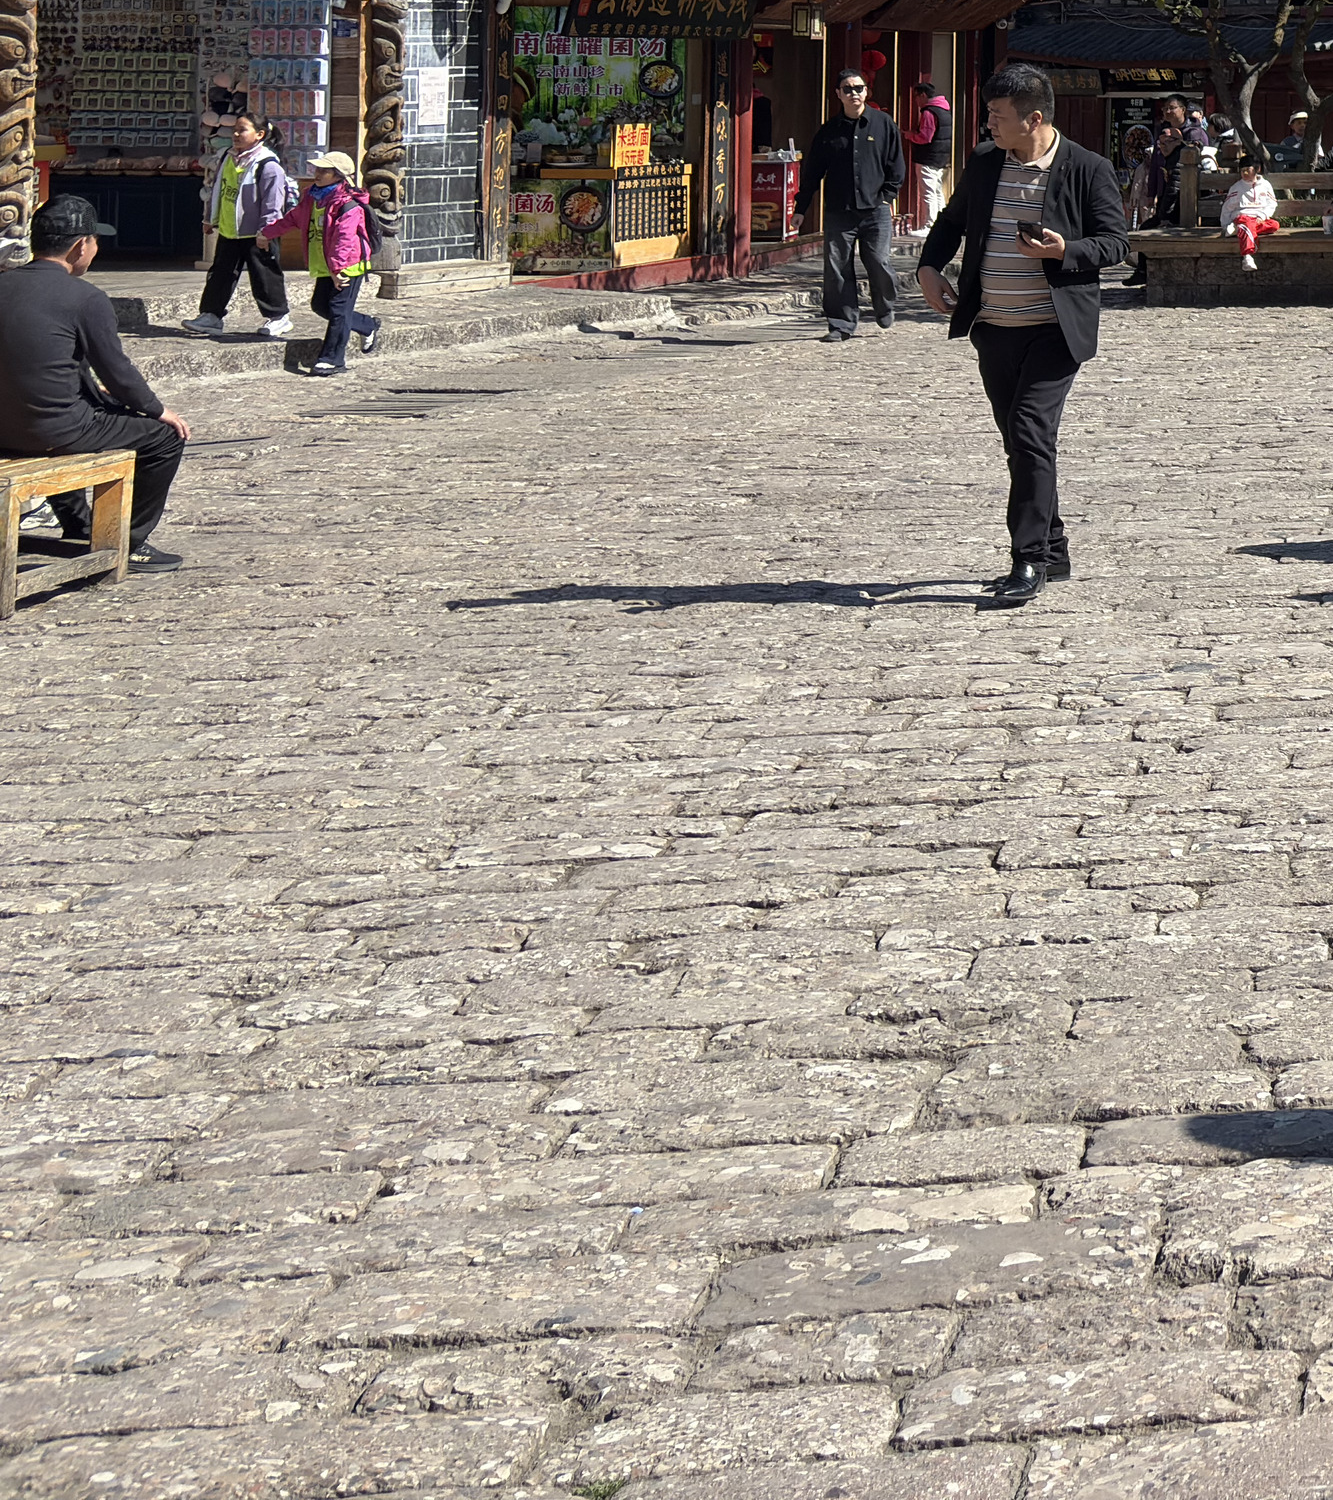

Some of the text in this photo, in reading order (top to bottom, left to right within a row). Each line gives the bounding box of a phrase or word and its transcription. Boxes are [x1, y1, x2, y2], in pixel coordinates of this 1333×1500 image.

[536, 64, 606, 79] 云南山珍
[553, 83, 624, 97] 新鲜上市
[508, 192, 556, 215] 菌汤
